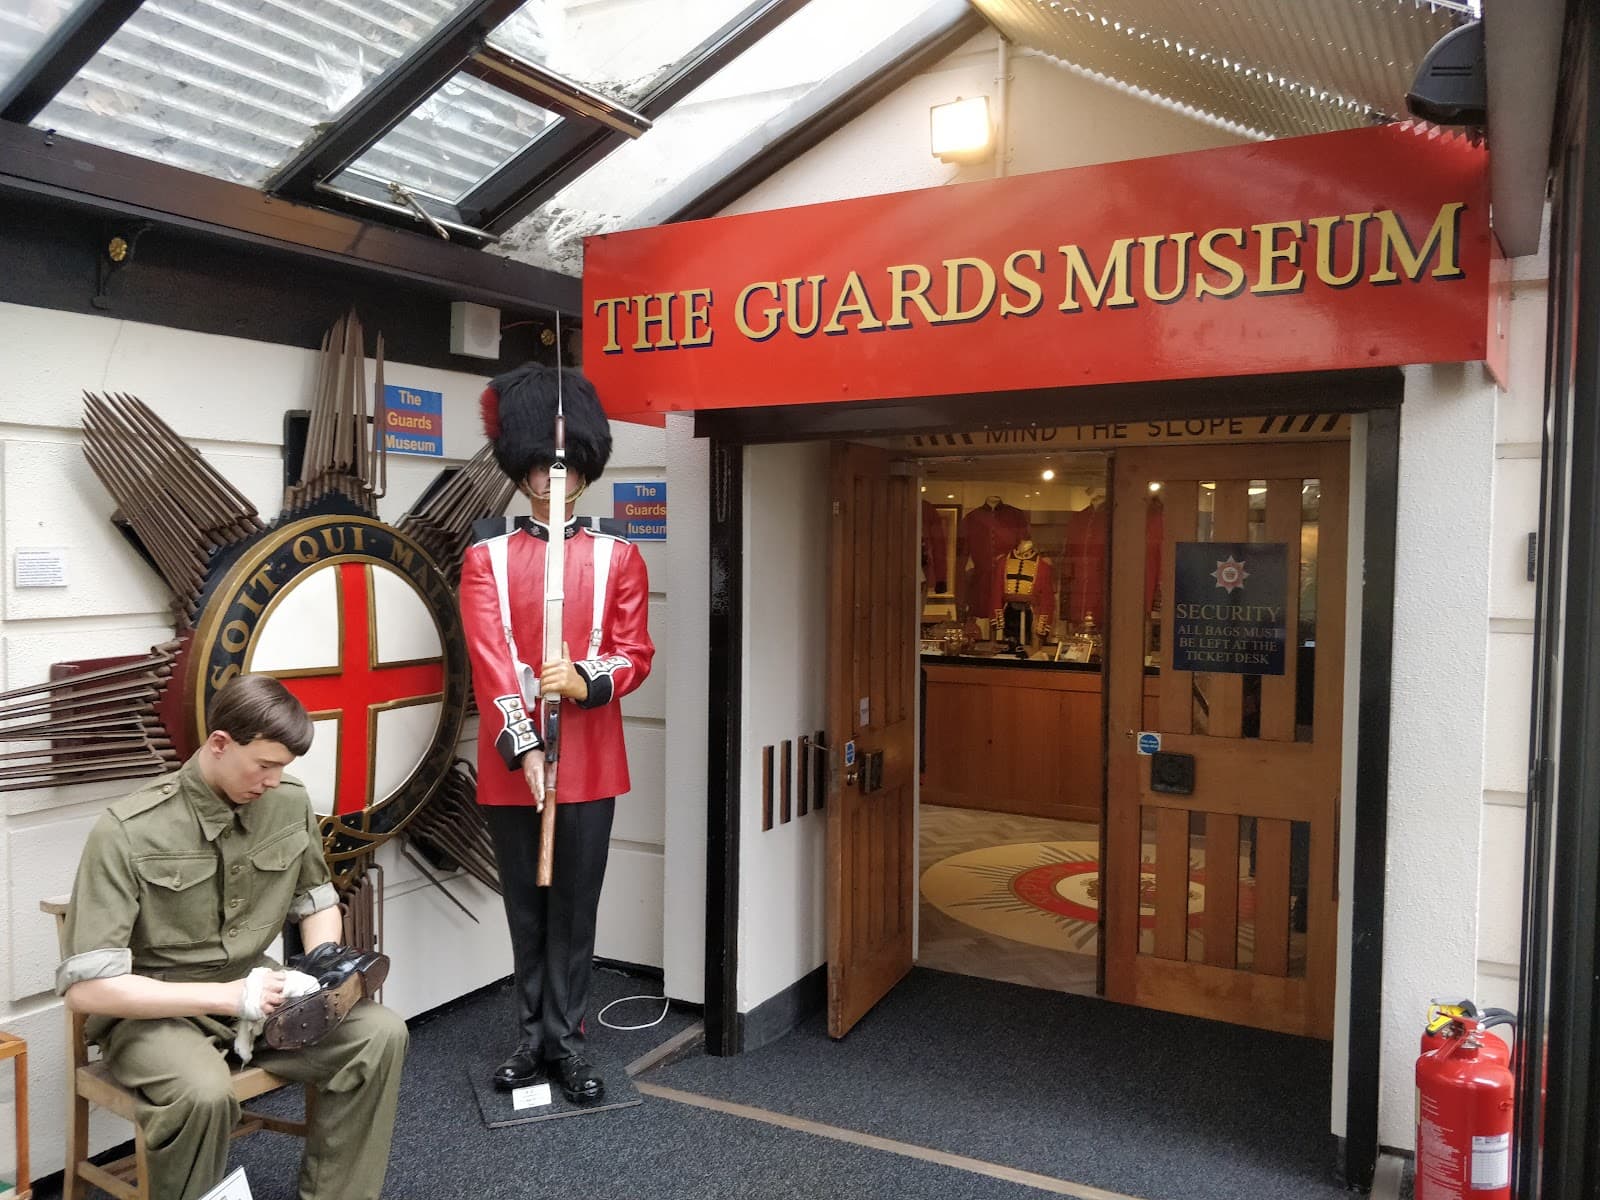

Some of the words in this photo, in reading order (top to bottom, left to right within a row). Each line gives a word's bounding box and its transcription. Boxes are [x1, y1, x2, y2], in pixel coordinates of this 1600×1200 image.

[593, 287, 714, 354] THE
[733, 248, 1044, 341] GUARDS
[1057, 201, 1466, 314] MUSEUM
[398, 389, 422, 406] The
[386, 411, 433, 430] Guards
[1147, 417, 1243, 437] SLOPE
[385, 434, 436, 453] Museum
[634, 484, 657, 497] The
[625, 503, 667, 516] Guards
[210, 563, 284, 691] SOIT
[292, 526, 366, 563] QUI
[1176, 602, 1282, 622] SECURITY
[1178, 624, 1202, 635] ALL
[1205, 625, 1240, 637] BAGS
[1242, 627, 1283, 639] MUST
[1179, 637, 1197, 648] BE
[1199, 638, 1232, 649] LEFT
[1232, 640, 1250, 651] AT
[1250, 640, 1278, 652] THE
[1184, 650, 1234, 662] TICKET
[1235, 653, 1270, 665] DESK
